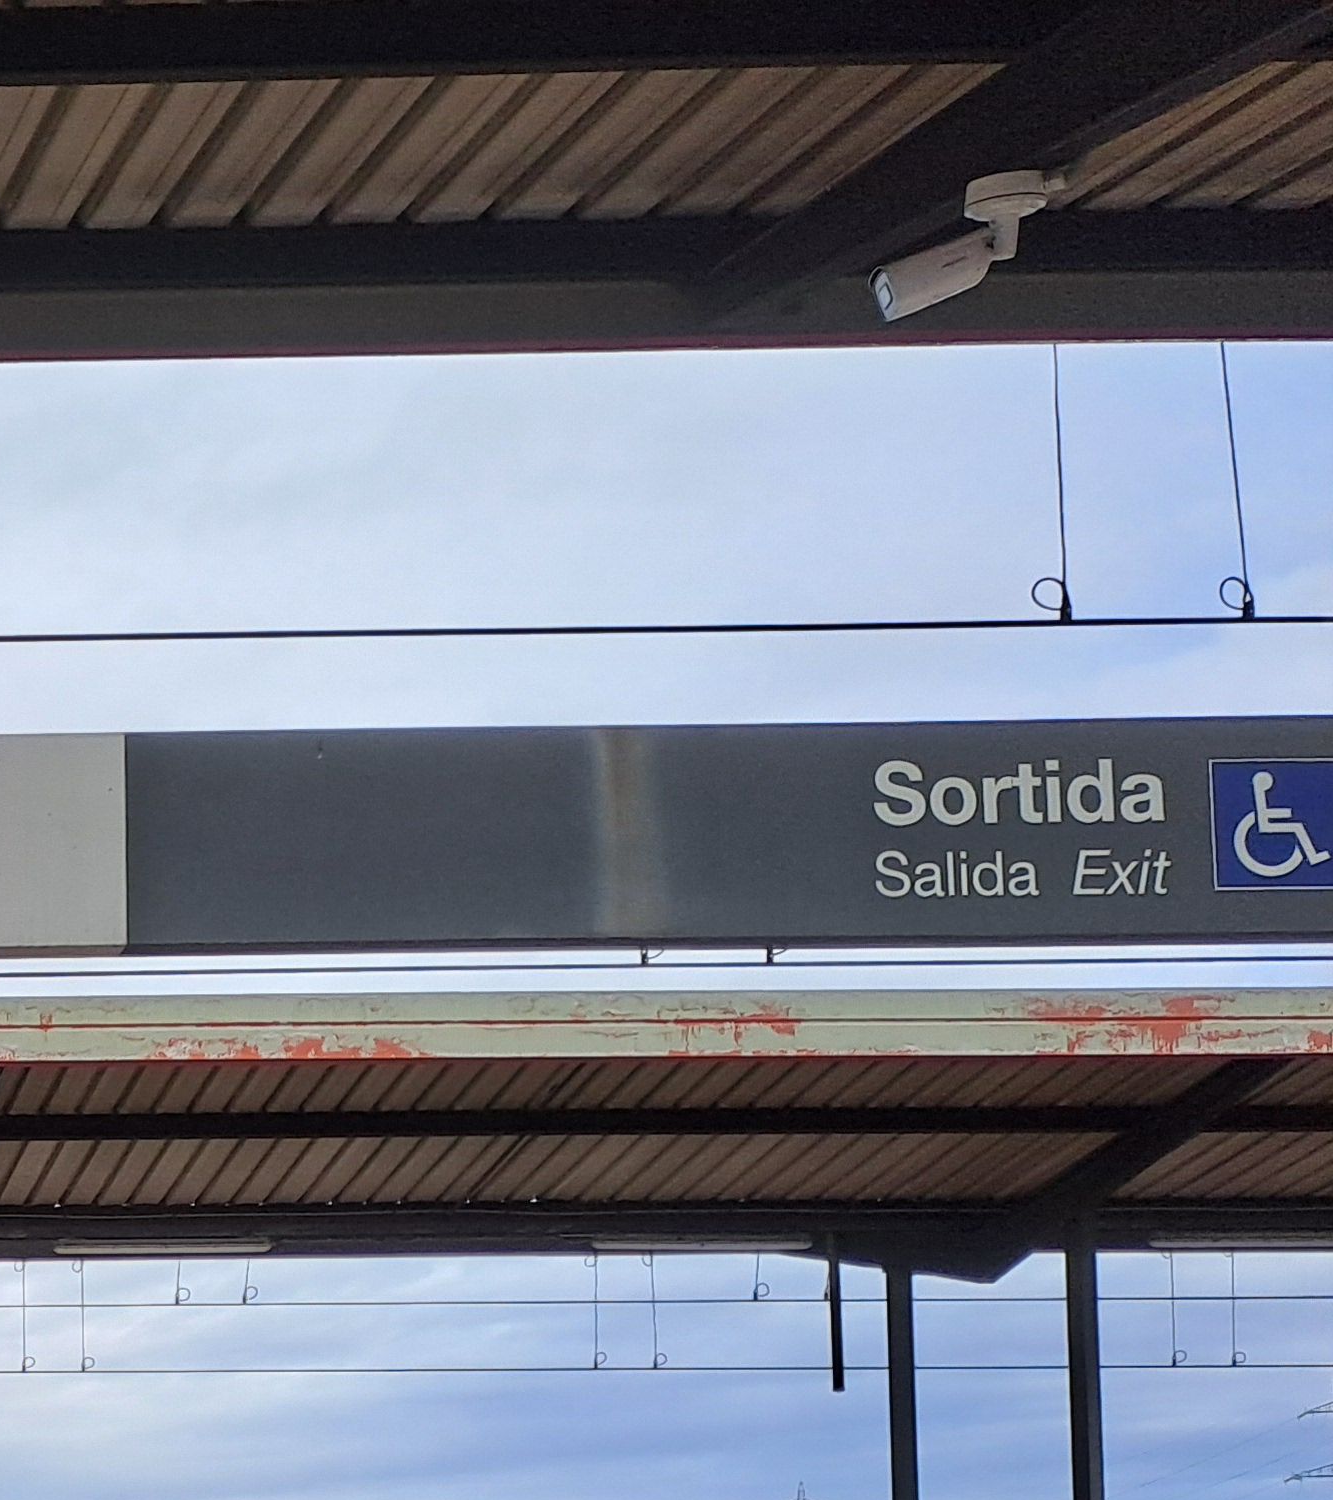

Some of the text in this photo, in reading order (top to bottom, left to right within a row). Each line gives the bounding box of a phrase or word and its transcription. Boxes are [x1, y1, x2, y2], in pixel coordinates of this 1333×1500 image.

[873, 758, 1166, 826] Sortida
[874, 848, 1172, 898] Salida Exit
